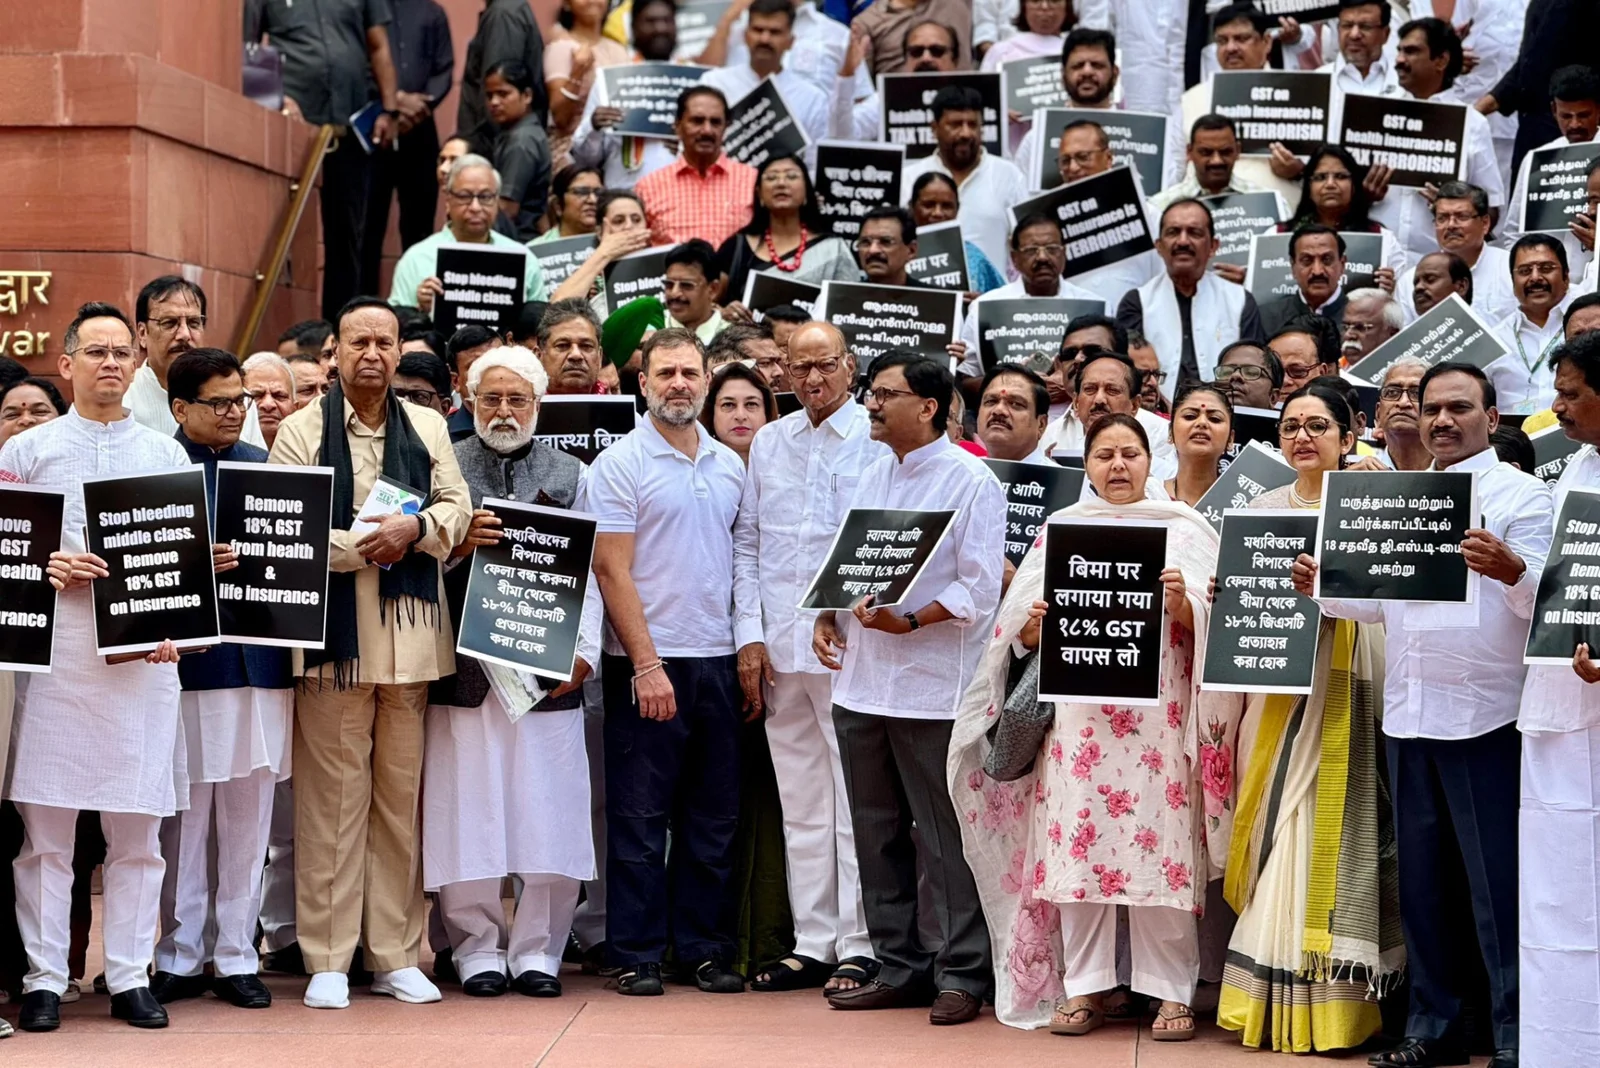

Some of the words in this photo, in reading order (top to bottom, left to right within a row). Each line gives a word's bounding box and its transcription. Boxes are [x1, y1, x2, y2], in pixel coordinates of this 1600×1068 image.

[1251, 86, 1273, 101] GST
[1273, 87, 1290, 101] on
[1252, 105, 1311, 119] insurance
[1311, 106, 1324, 120] is
[1242, 122, 1324, 141] TERRORISM
[1383, 114, 1405, 130] GST
[1406, 117, 1423, 132] on
[1345, 128, 1383, 146] health
[1384, 132, 1444, 152] insurance
[1444, 139, 1457, 153] is
[1057, 201, 1080, 221] GST
[1081, 197, 1098, 214] on
[1065, 208, 1126, 239] insurance
[1123, 203, 1138, 217] is
[443, 270, 469, 286] Stop
[469, 272, 517, 290] bleeding
[613, 281, 637, 295] Stop
[444, 289, 481, 303] middle
[456, 306, 499, 321] Remove
[1012, 481, 1046, 499] आणि
[244, 495, 304, 514] Remove
[1008, 502, 1046, 518] म्यावर
[1340, 495, 1406, 512] மருத்துவம்
[1408, 495, 1455, 511] மற்றும்
[99, 511, 131, 527] Stop
[132, 504, 195, 522] bleeding
[1202, 505, 1222, 522] ১৮
[244, 517, 272, 535] 18%
[275, 519, 303, 536] GST
[1024, 524, 1043, 537] GS
[1339, 516, 1452, 533] உயிர்க்காப்பீட்டில்
[1565, 519, 1597, 536] Stop
[103, 530, 151, 549] middle
[153, 527, 195, 542] class.
[503, 526, 571, 550] মধ্যবিত্তদের
[866, 529, 899, 542] स्वास्थ्य
[898, 527, 923, 542] आणि
[1243, 531, 1307, 551] মধ্যবিত্তদের
[0, 538, 31, 557] GST
[230, 539, 265, 557] from
[267, 541, 314, 560] health
[855, 543, 882, 559] जीवन
[880, 544, 917, 559] विम्यावर
[1004, 540, 1028, 555] ाका
[1324, 539, 1337, 551] 18
[1338, 538, 1378, 553] சதவீத
[123, 551, 179, 569] Remove
[511, 544, 557, 566] বিপাকে
[264, 565, 276, 580] &
[483, 562, 515, 580] ফেলা
[517, 567, 538, 583] বন্ধ
[539, 572, 577, 589] করুন।
[837, 561, 876, 577] लावलेला
[874, 565, 894, 579] १८%
[894, 563, 914, 576] GST
[1068, 554, 1112, 580] बिमा
[1116, 562, 1142, 581] पर
[1368, 561, 1416, 577] அகற்று
[124, 574, 153, 591] 18%
[154, 571, 182, 588] GST
[842, 580, 872, 596] काढून
[1225, 575, 1257, 590] ফেলা
[1258, 577, 1279, 591] বন্ধ
[219, 583, 243, 600] life
[245, 584, 320, 605] insurance
[497, 579, 524, 597] বীমা
[524, 589, 558, 604] থেকে
[1054, 588, 1113, 608] लगाया
[1116, 591, 1153, 610] गया
[1564, 584, 1589, 601] 18%
[109, 601, 129, 616] on
[129, 594, 201, 613] insurance
[1239, 592, 1265, 609] বীমা
[1266, 595, 1298, 610] থেকে
[0, 610, 47, 628] rance
[481, 597, 515, 614] ১৮%
[517, 602, 567, 624] জিএসটি
[1543, 610, 1561, 624] on
[494, 617, 548, 638] প্রত্যাহার
[1059, 617, 1100, 637] १८%
[1105, 620, 1146, 638] GST
[1224, 614, 1257, 630] ১৮%
[1259, 612, 1307, 631] জিএসটি
[489, 631, 515, 648] করা
[515, 639, 547, 655] হোক
[1238, 634, 1288, 651] প্রত্যাহার
[1060, 646, 1112, 666] वापस
[1116, 642, 1141, 667] लो
[1233, 655, 1258, 670] করা
[1259, 656, 1289, 671] হোক
